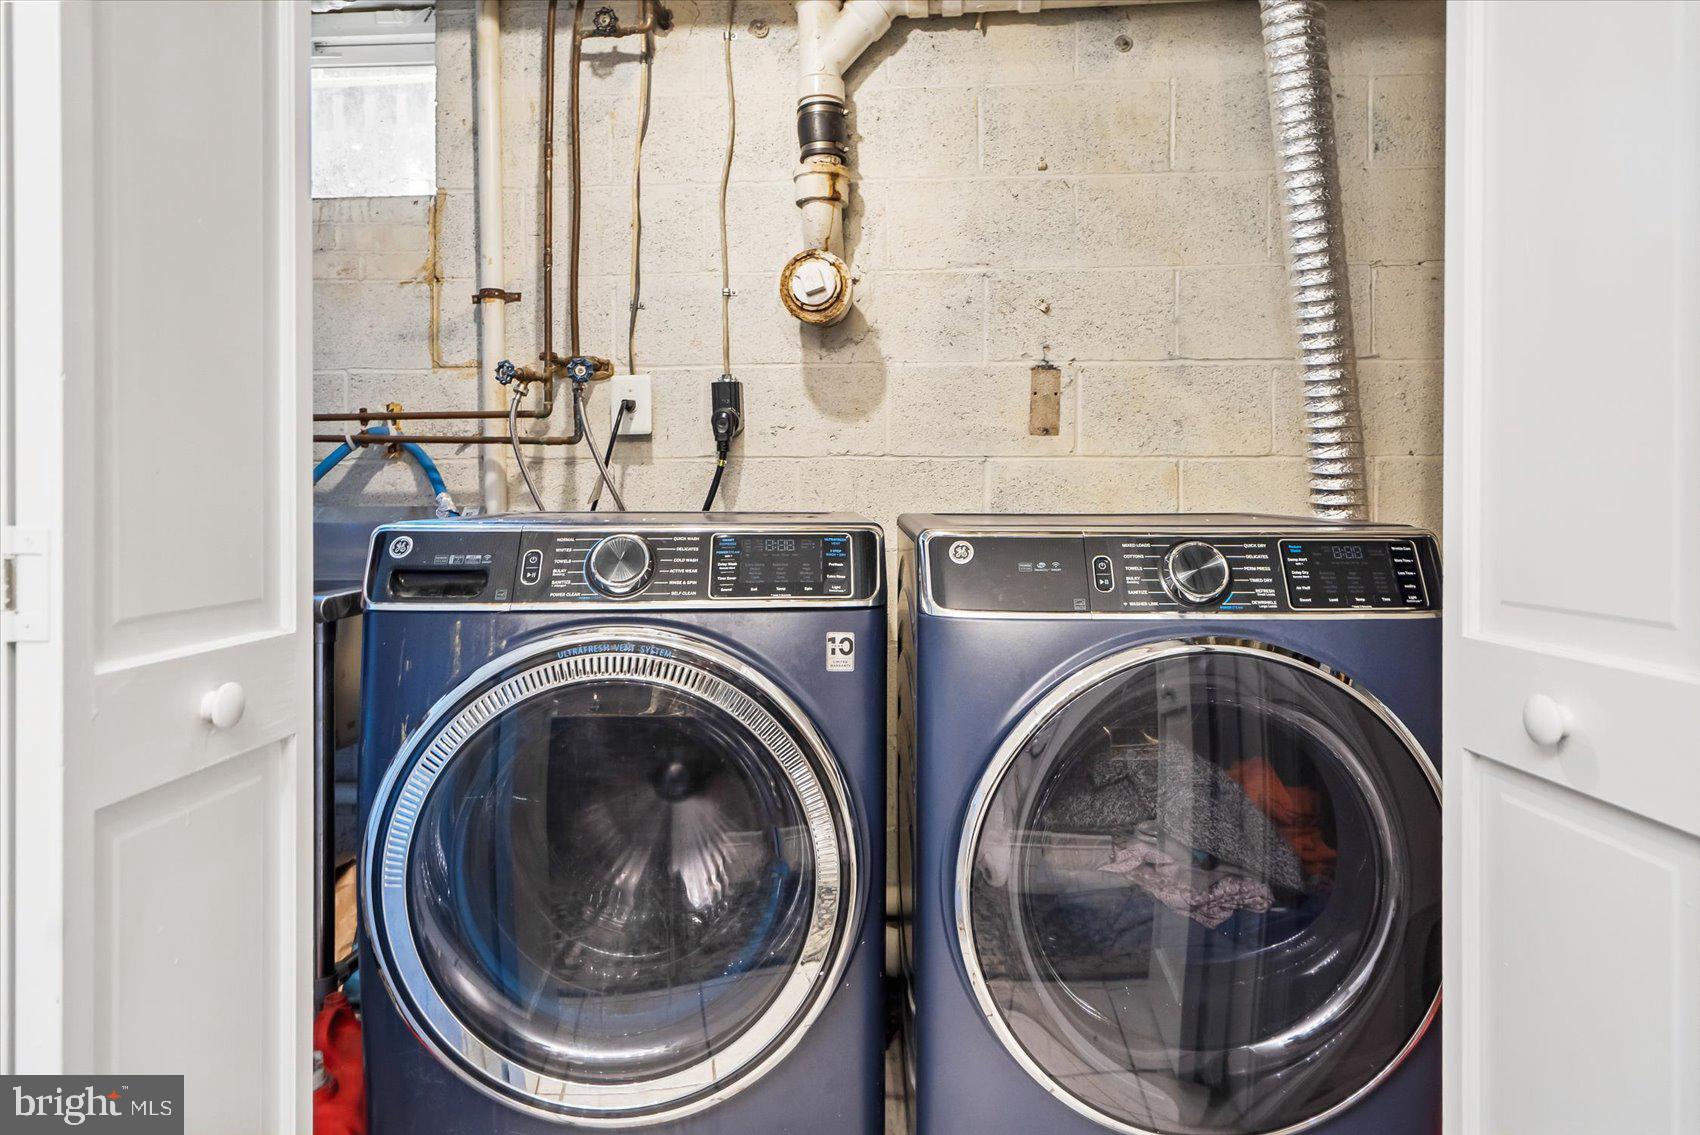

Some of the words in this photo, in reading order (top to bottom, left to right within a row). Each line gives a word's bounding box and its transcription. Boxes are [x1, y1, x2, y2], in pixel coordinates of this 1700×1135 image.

[557, 644, 610, 659] ULTRAFRESH
[615, 644, 636, 652] VENT
[641, 644, 673, 658] SYSTEM
[828, 637, 853, 656] 10
